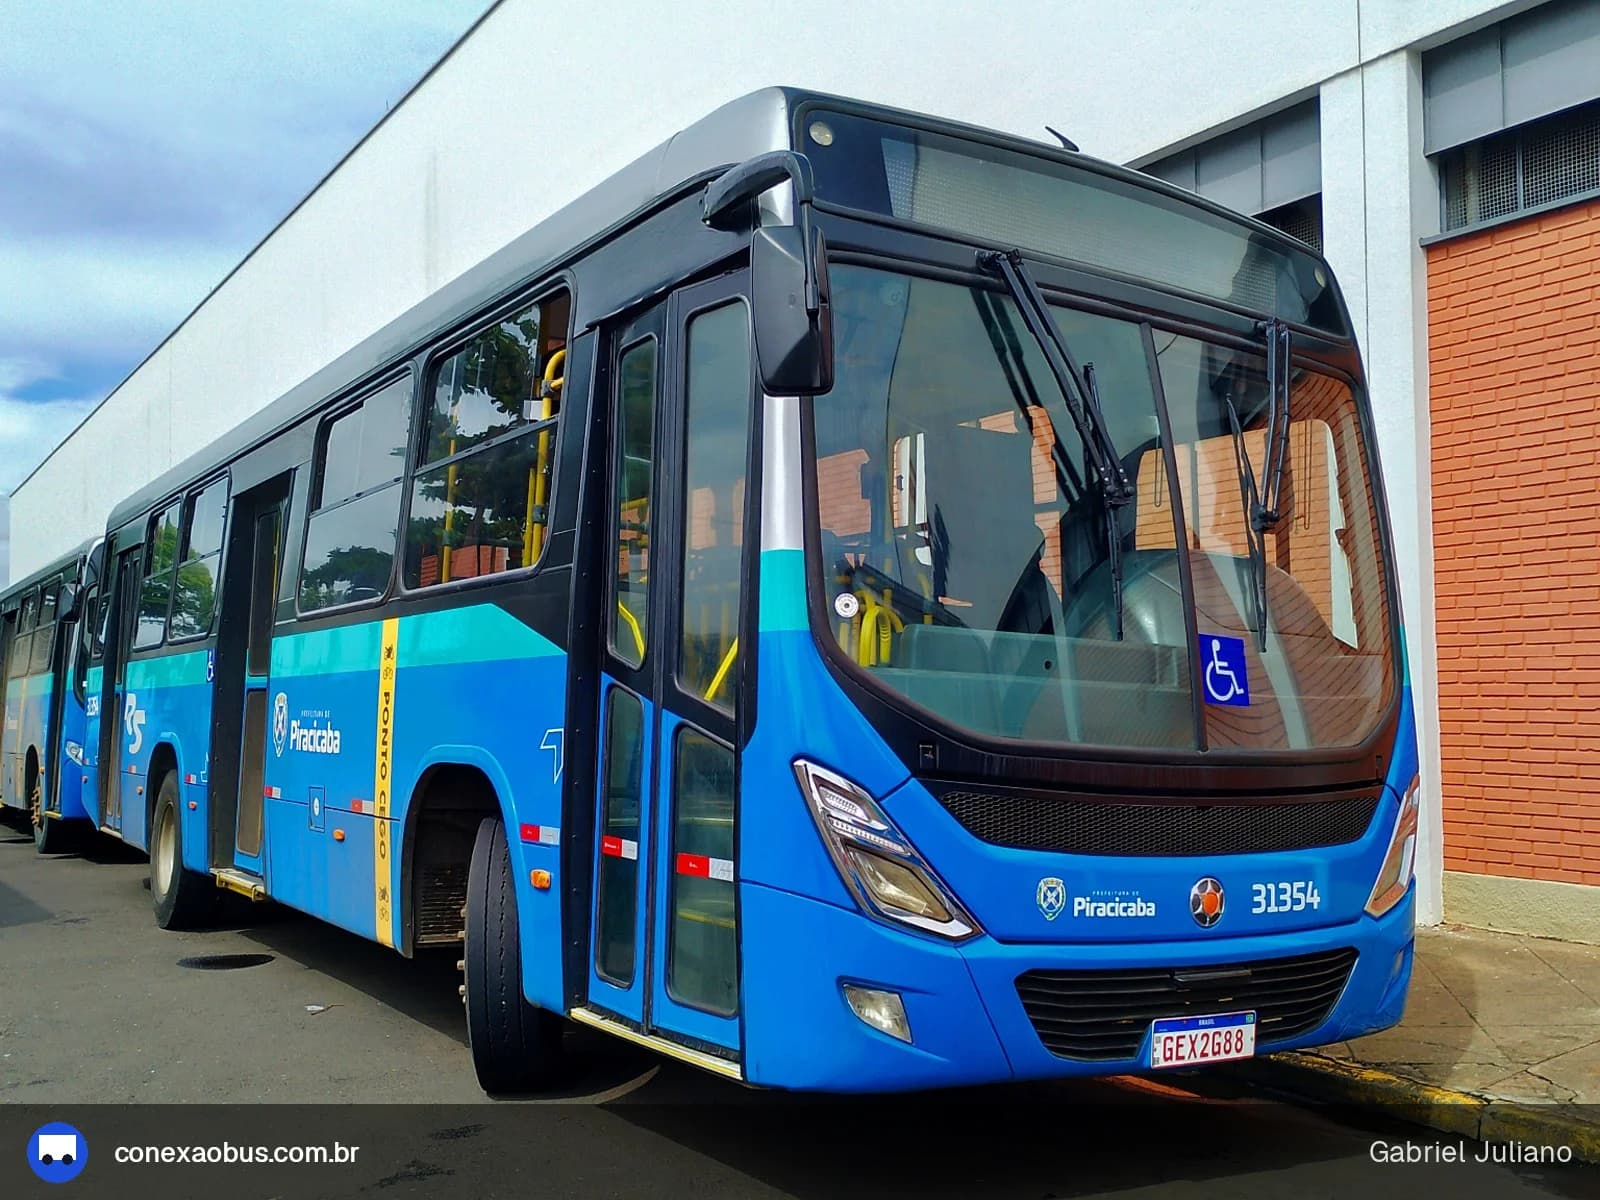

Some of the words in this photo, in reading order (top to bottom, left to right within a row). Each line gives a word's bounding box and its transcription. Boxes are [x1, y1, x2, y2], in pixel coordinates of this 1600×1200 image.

[289, 719, 341, 754] Piracicaba
[380, 692, 390, 781] PONTO
[1073, 896, 1156, 917] Piracicaba
[1251, 880, 1321, 914] 31354
[1162, 1028, 1244, 1063] GEX2G88
